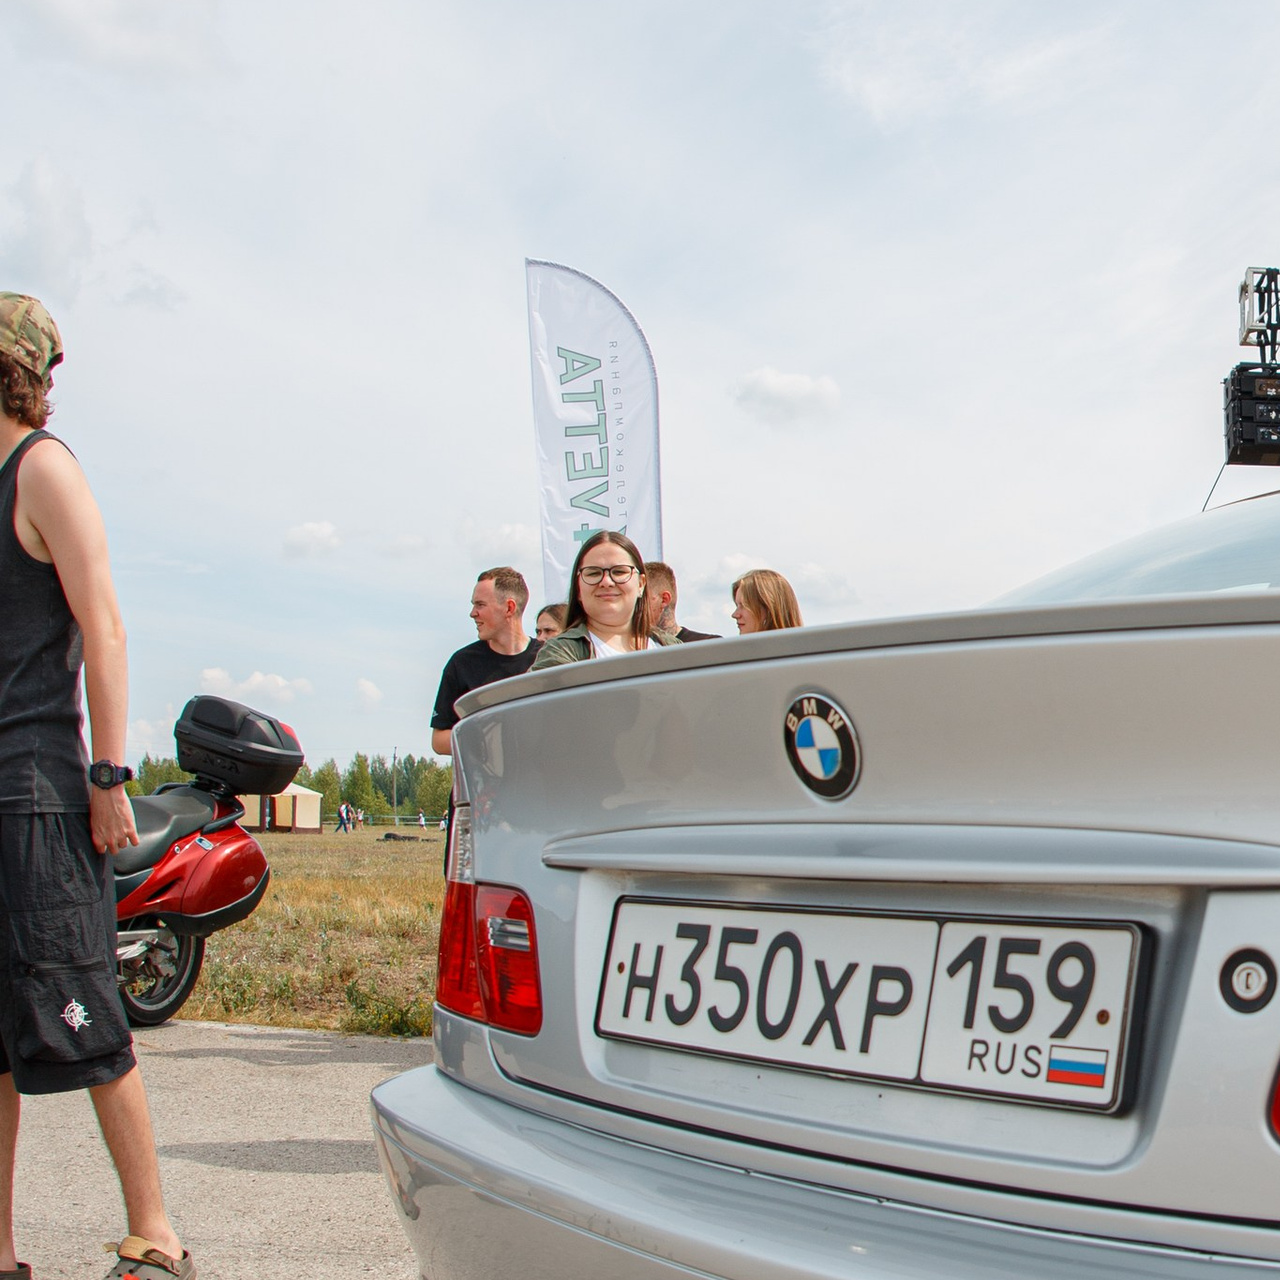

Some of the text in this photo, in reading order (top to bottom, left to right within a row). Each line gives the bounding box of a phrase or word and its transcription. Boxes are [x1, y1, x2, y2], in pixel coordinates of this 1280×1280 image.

[787, 698, 844, 732] BMW
[947, 936, 1096, 1039] 159
[968, 1039, 1042, 1078] RUS
